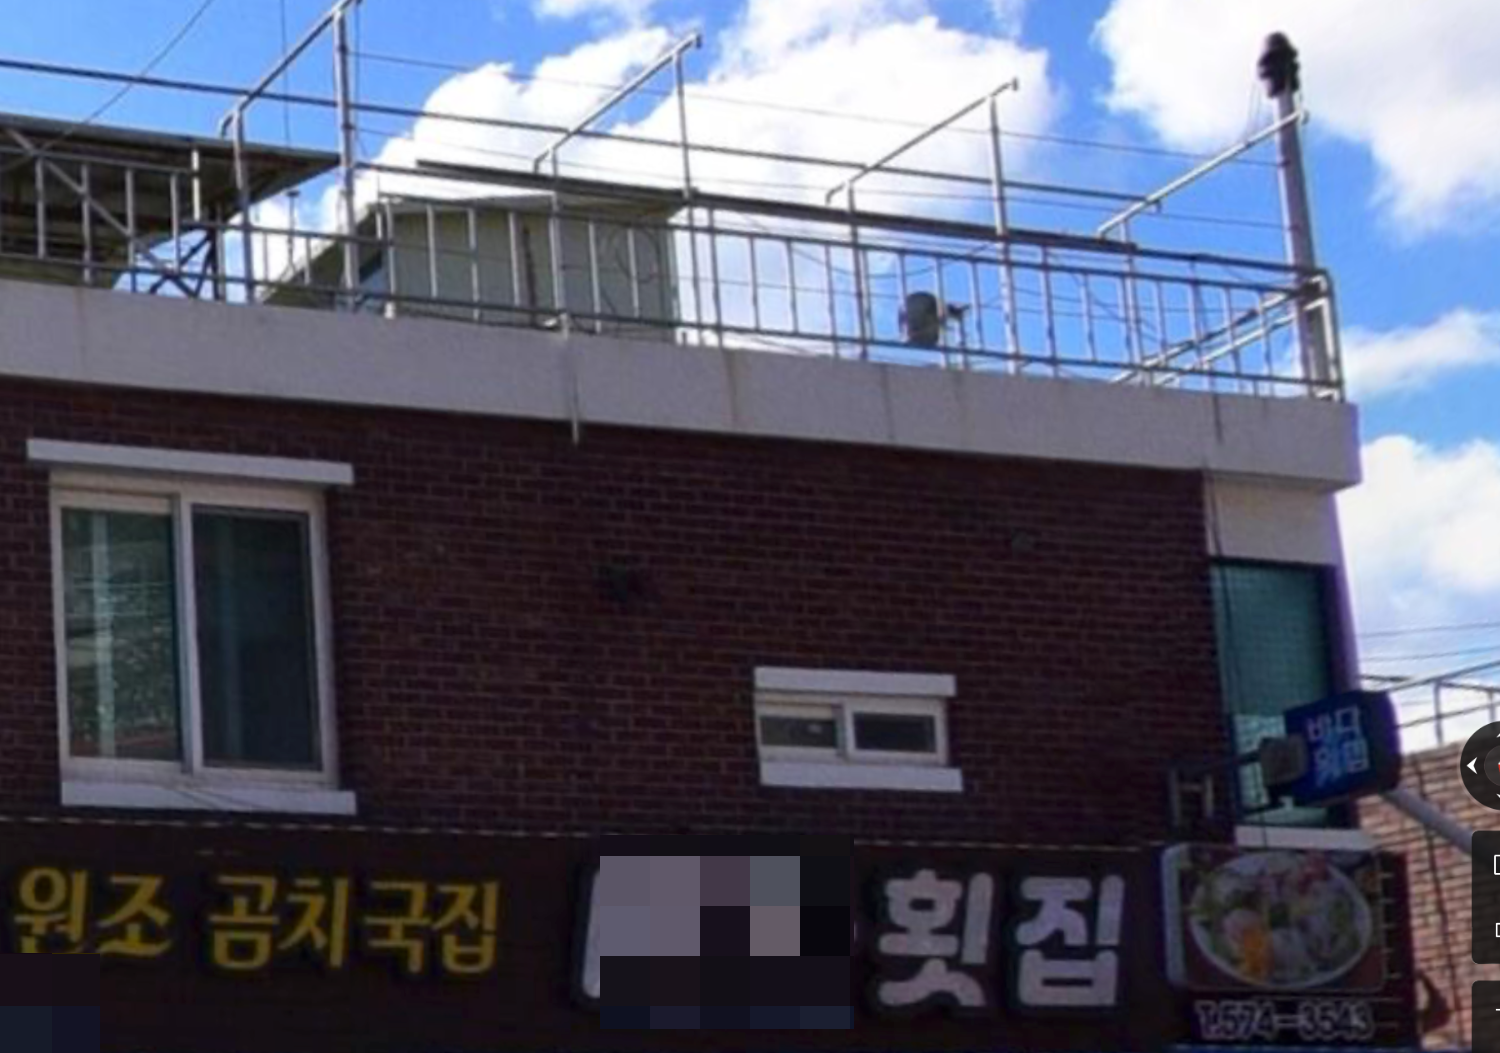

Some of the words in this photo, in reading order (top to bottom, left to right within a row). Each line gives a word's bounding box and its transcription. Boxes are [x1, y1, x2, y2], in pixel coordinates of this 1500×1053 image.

[12, 865, 175, 958] 원조
[206, 874, 502, 976] 곰치국집
[876, 866, 1127, 1008] 횟집
